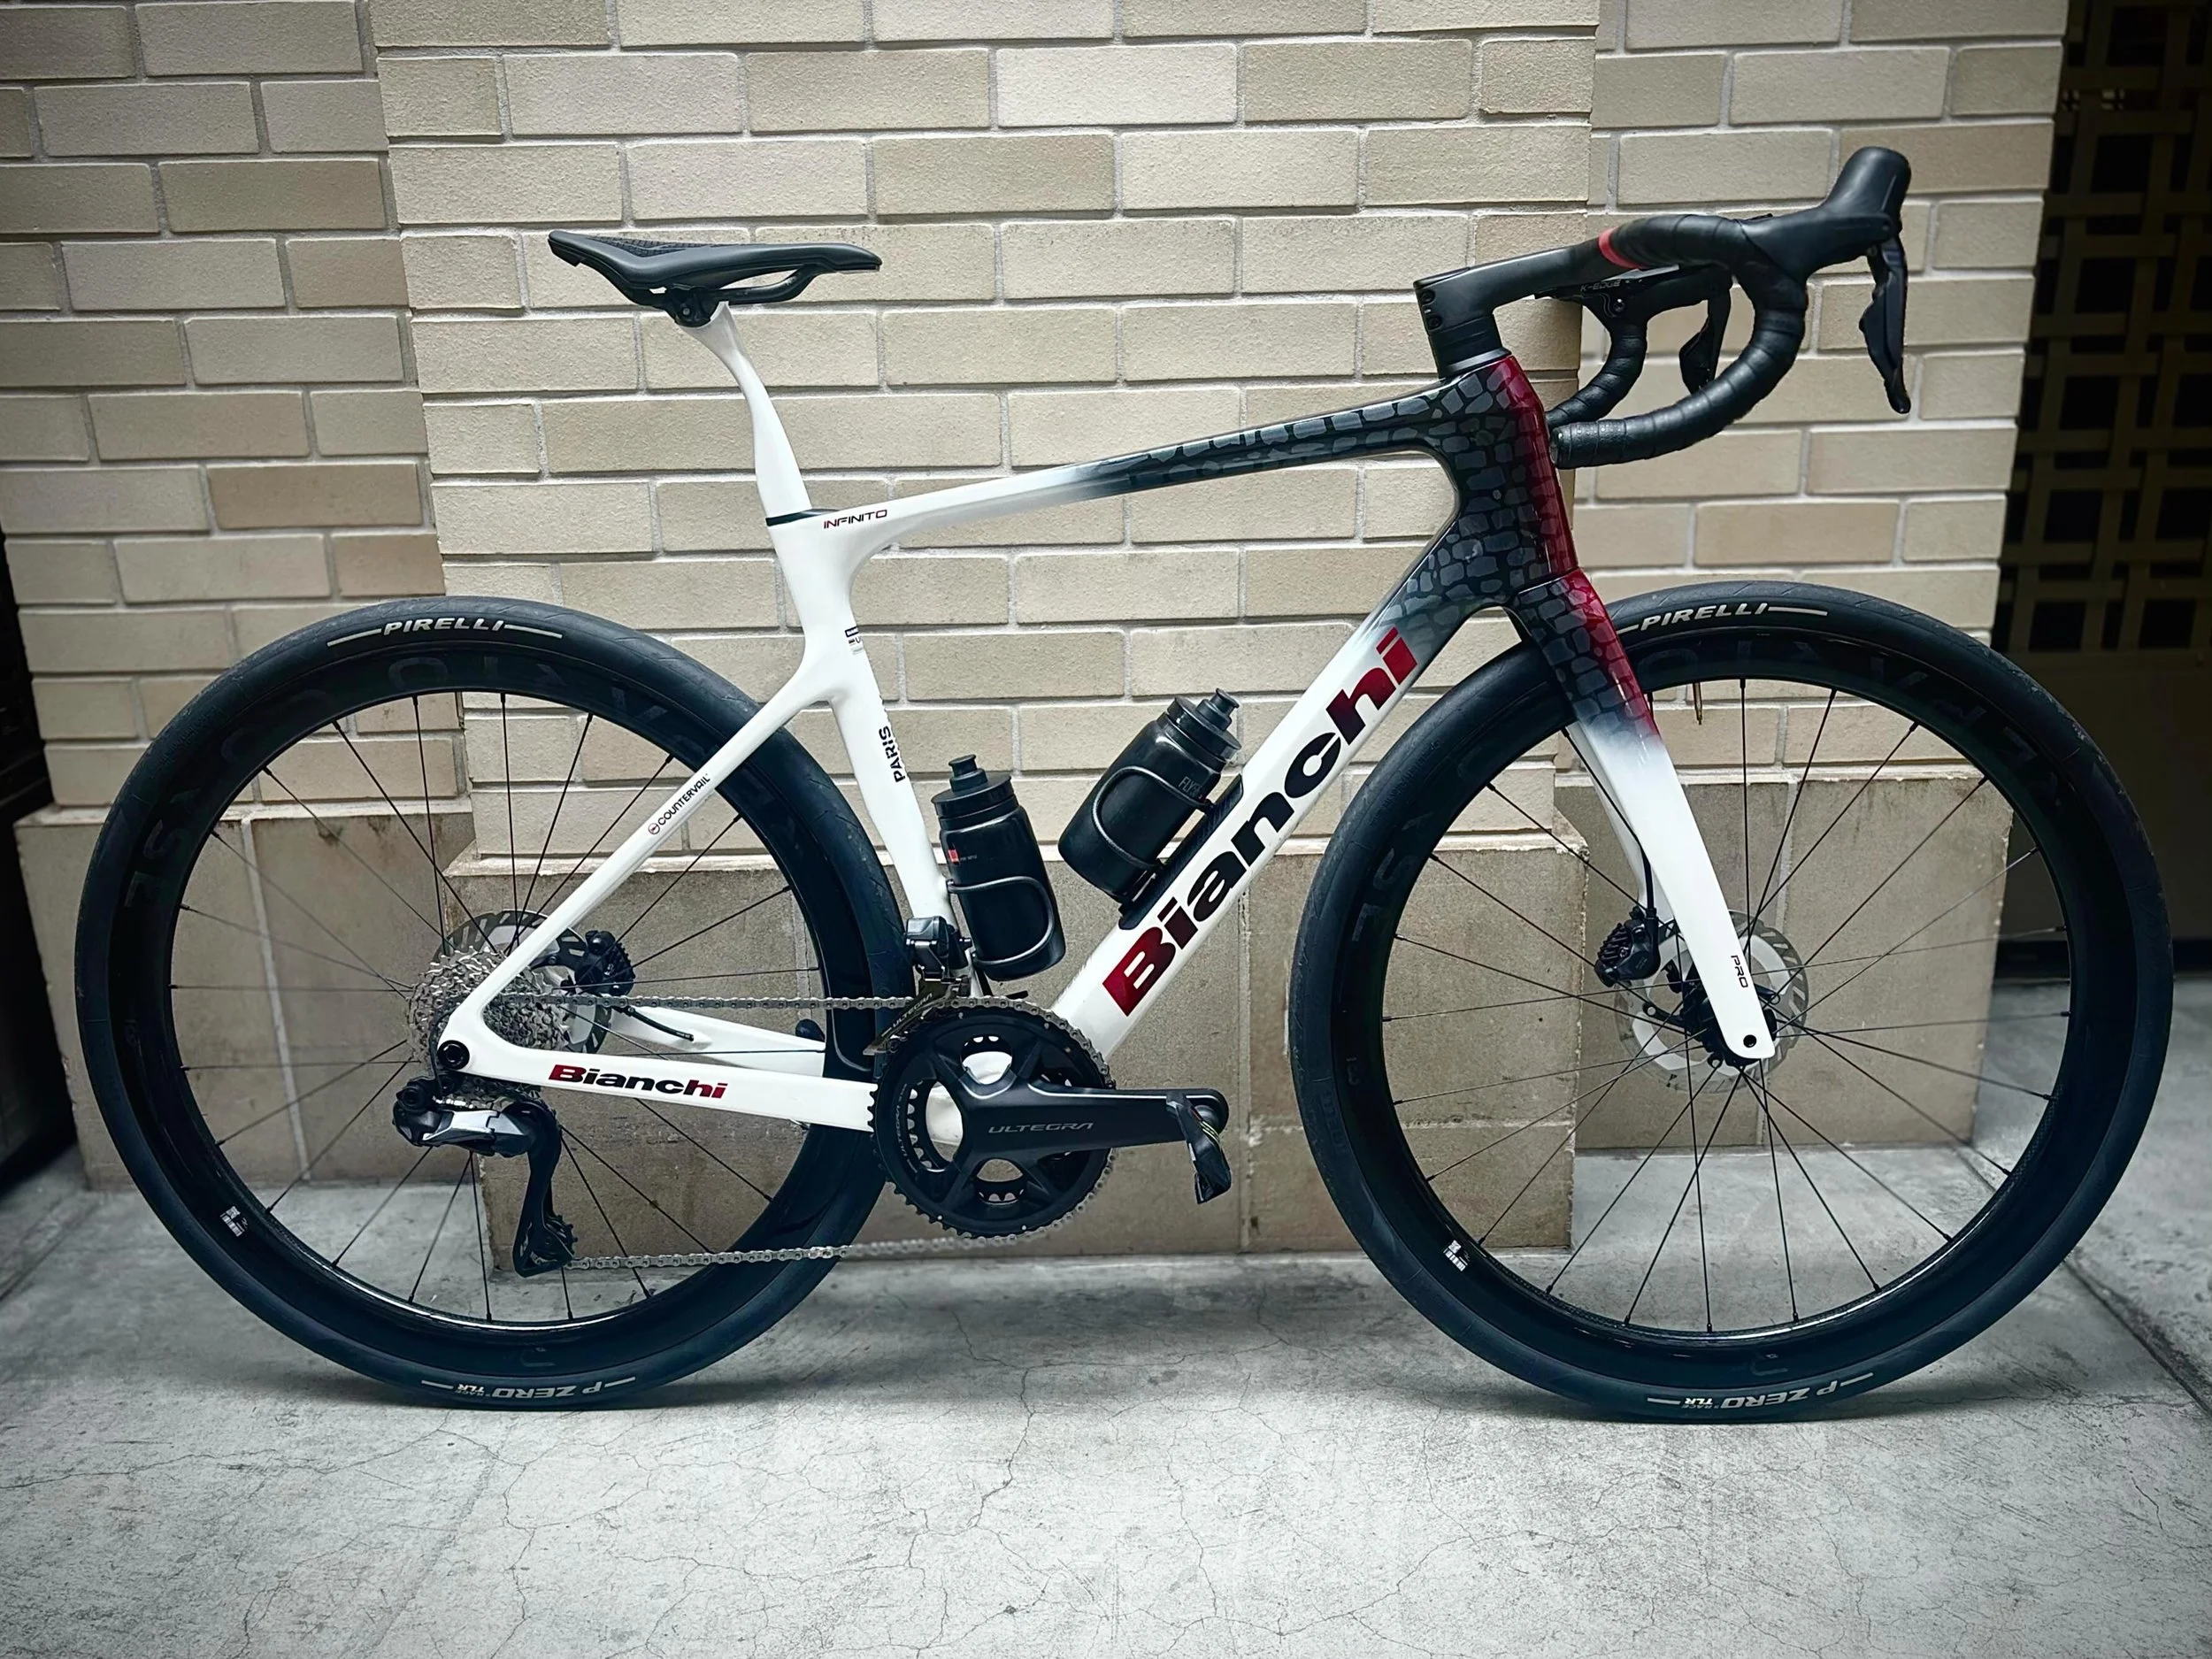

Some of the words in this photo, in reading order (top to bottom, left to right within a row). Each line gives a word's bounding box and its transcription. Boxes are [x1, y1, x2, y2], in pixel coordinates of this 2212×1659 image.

[823, 509, 888, 529] INFINITO
[383, 617, 504, 636] PIRELLI
[1640, 603, 1768, 631] PIRELLI
[879, 726, 906, 783] PARIS
[657, 776, 710, 826] COUNTERVAIL
[1102, 626, 1417, 1017] Bianchi
[1731, 955, 1749, 988] PRO
[548, 1064, 728, 1099] Bianchi
[987, 1122, 1094, 1133] ULTEGRA
[457, 1383, 485, 1393] TLR
[491, 1386, 578, 1399] ZERO
[581, 1381, 603, 1394] P
[1720, 1386, 1811, 1409] ZERO
[1816, 1380, 1839, 1396] P
